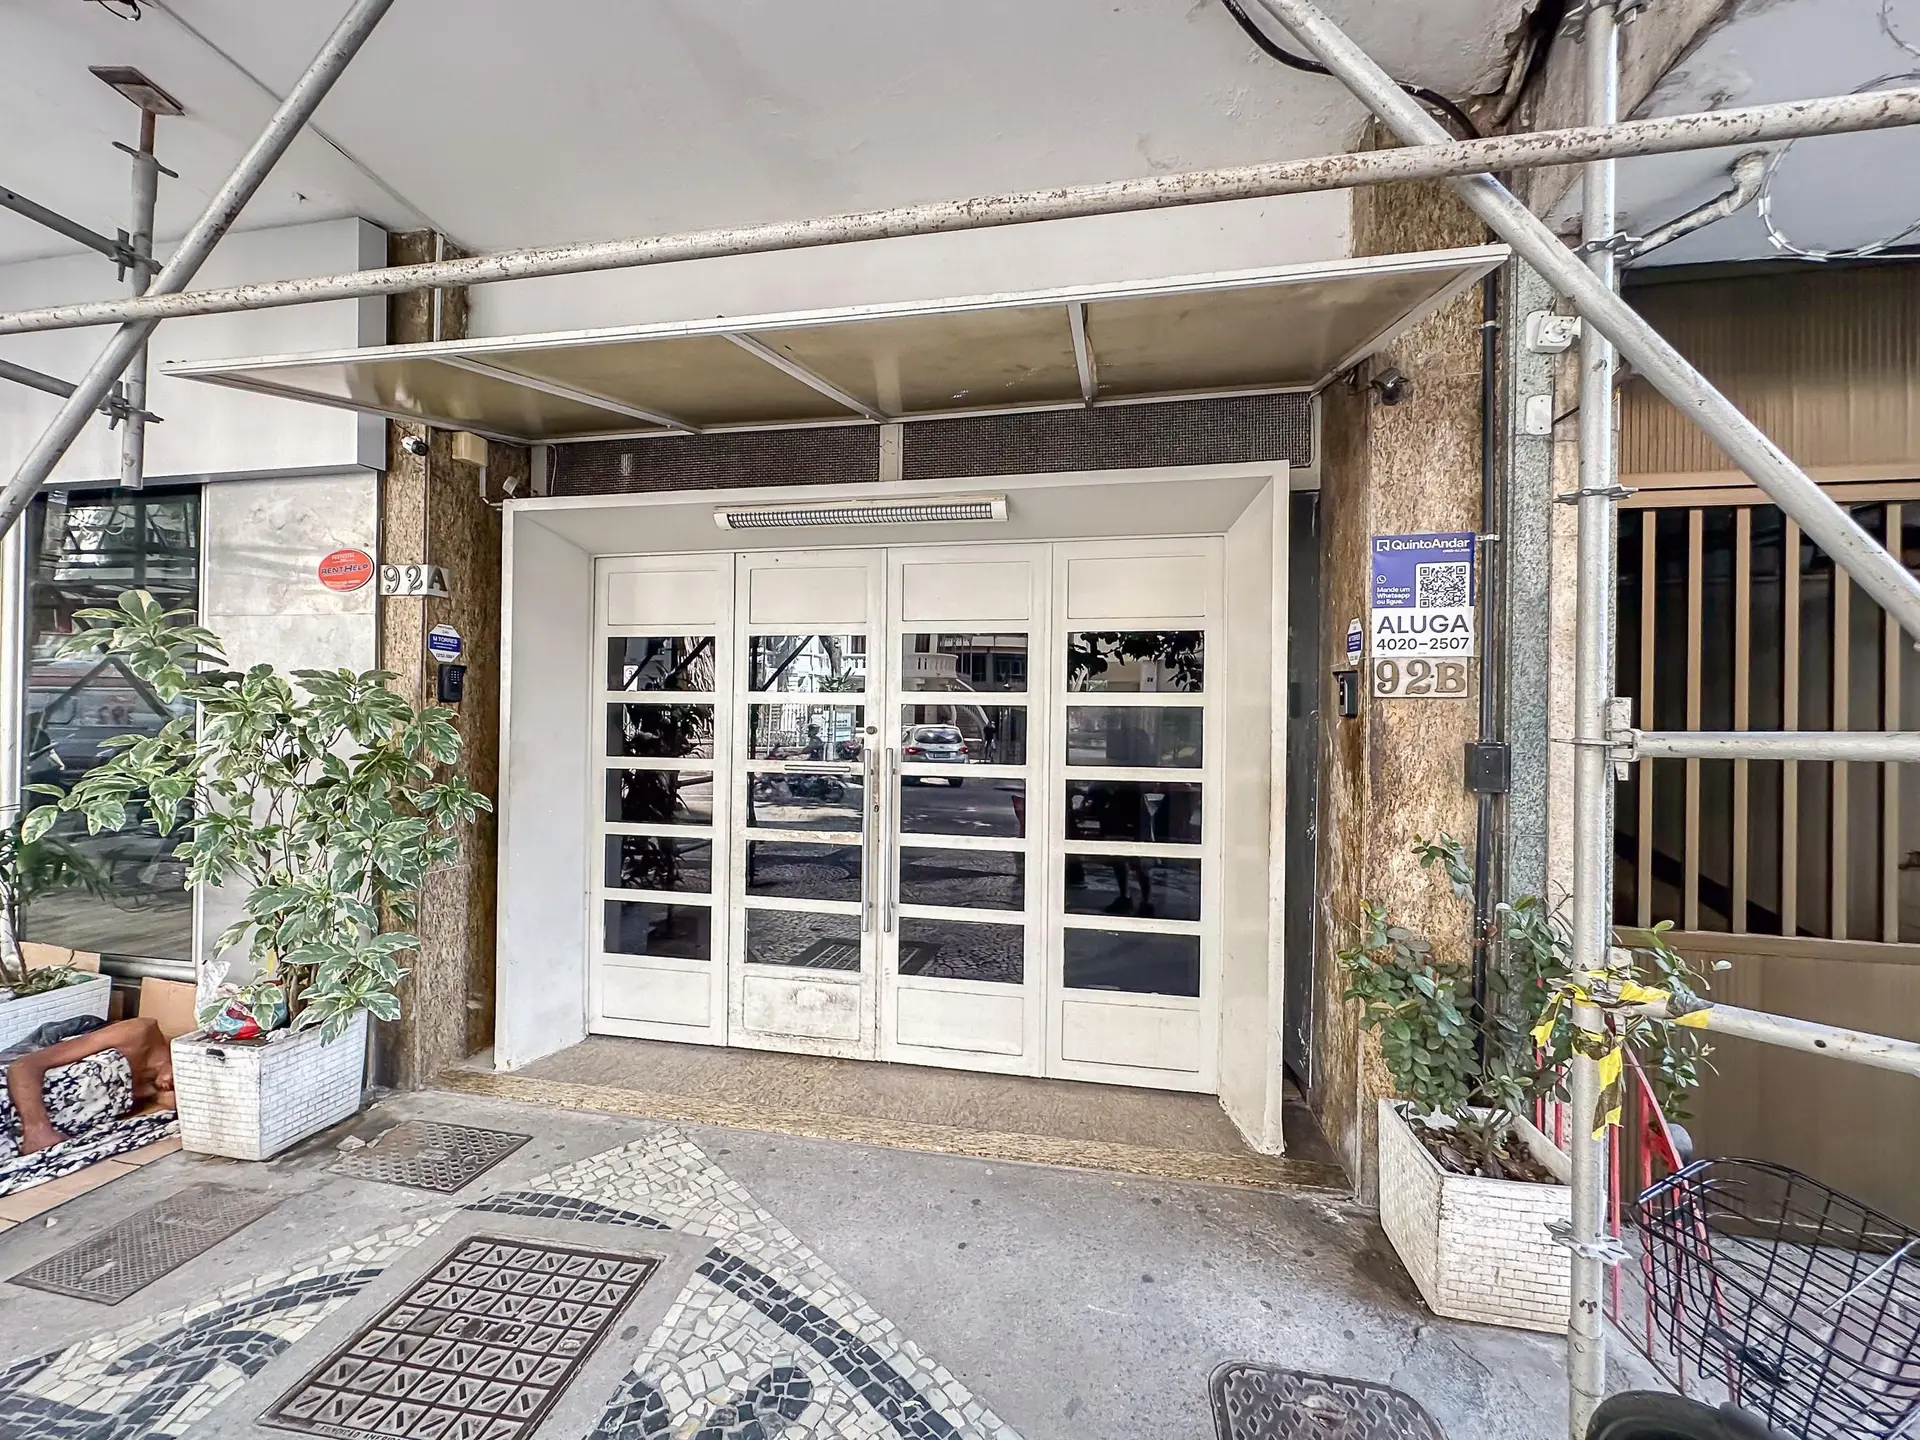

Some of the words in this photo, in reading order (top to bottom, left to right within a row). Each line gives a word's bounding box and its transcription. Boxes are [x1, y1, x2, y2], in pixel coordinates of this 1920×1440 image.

[1392, 538, 1470, 551] QuintoAndar
[383, 565, 448, 595] 92A
[1376, 614, 1470, 634] ALUGA
[1376, 637, 1470, 651] 4020-2507
[1376, 659, 1467, 695] 92B
